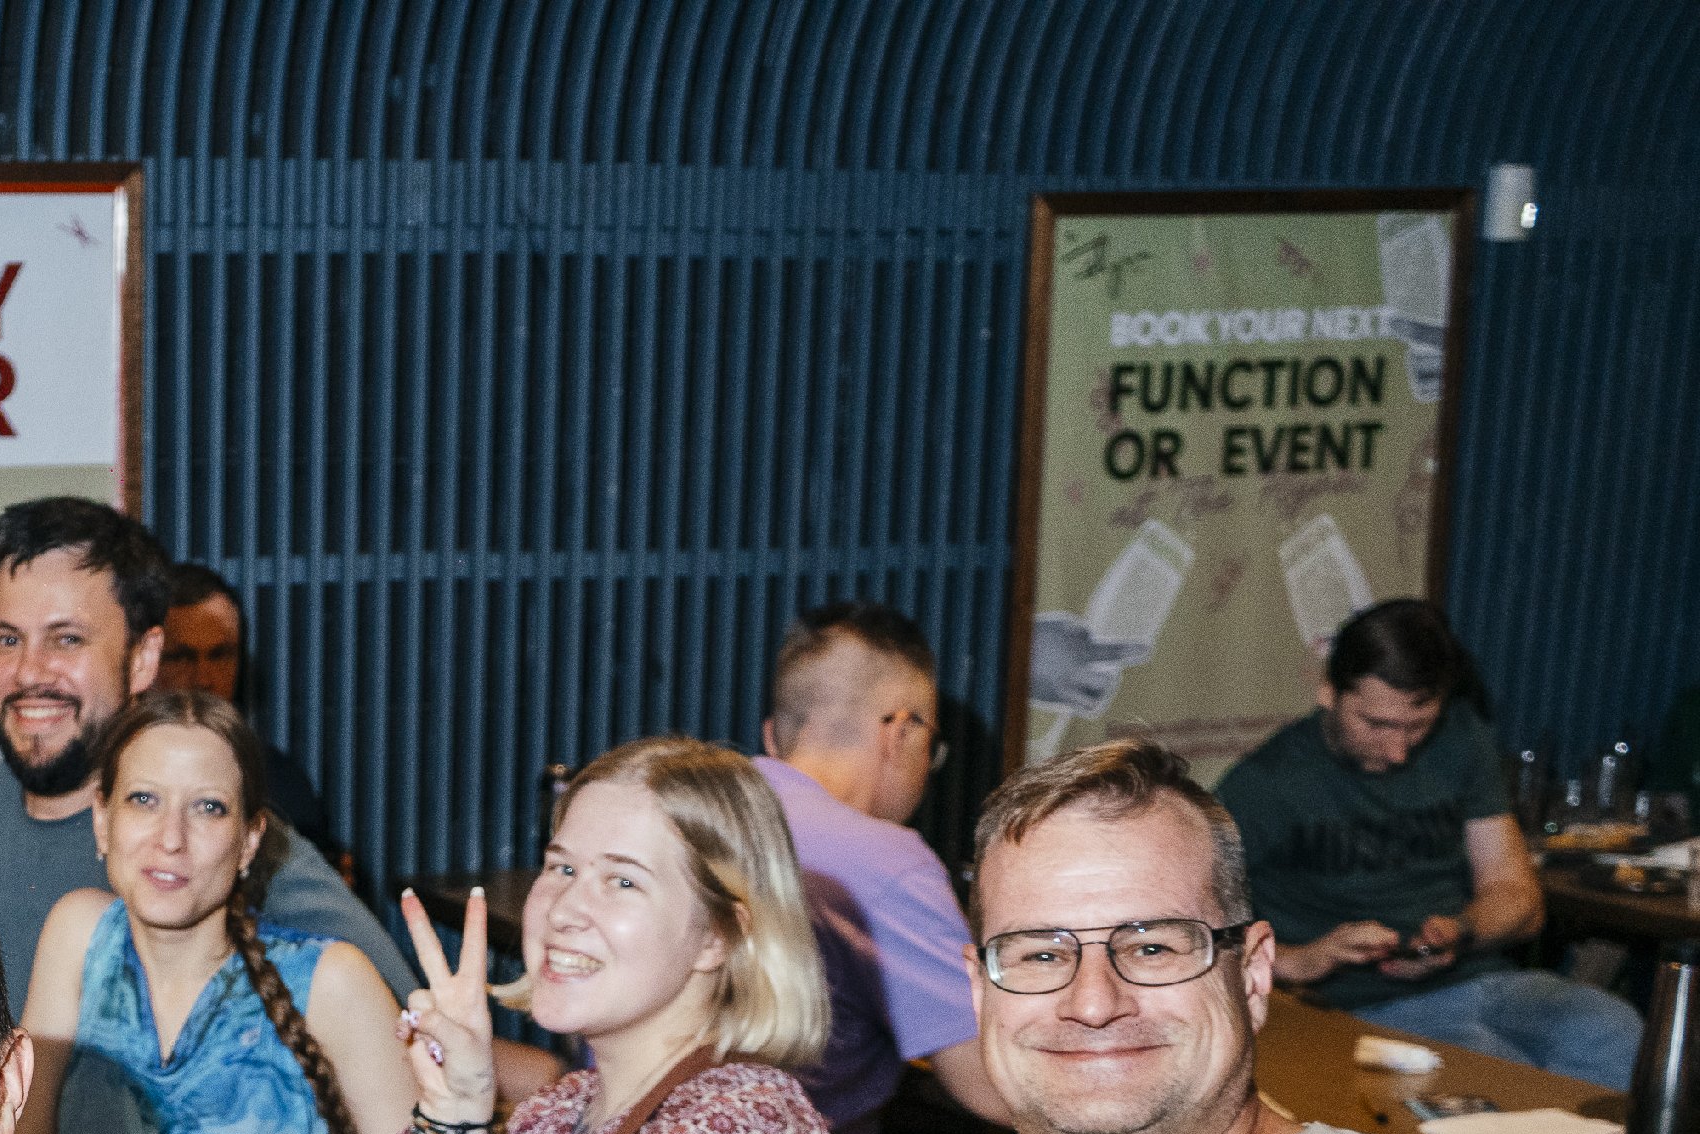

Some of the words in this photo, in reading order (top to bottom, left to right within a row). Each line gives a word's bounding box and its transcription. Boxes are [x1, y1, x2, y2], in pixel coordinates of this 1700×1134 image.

[1110, 312, 1209, 347] BOOK
[1211, 309, 1306, 344] YOUR
[1110, 355, 1386, 415] FUNCTION
[1104, 429, 1184, 481] OR
[1221, 421, 1386, 478] EVENT
